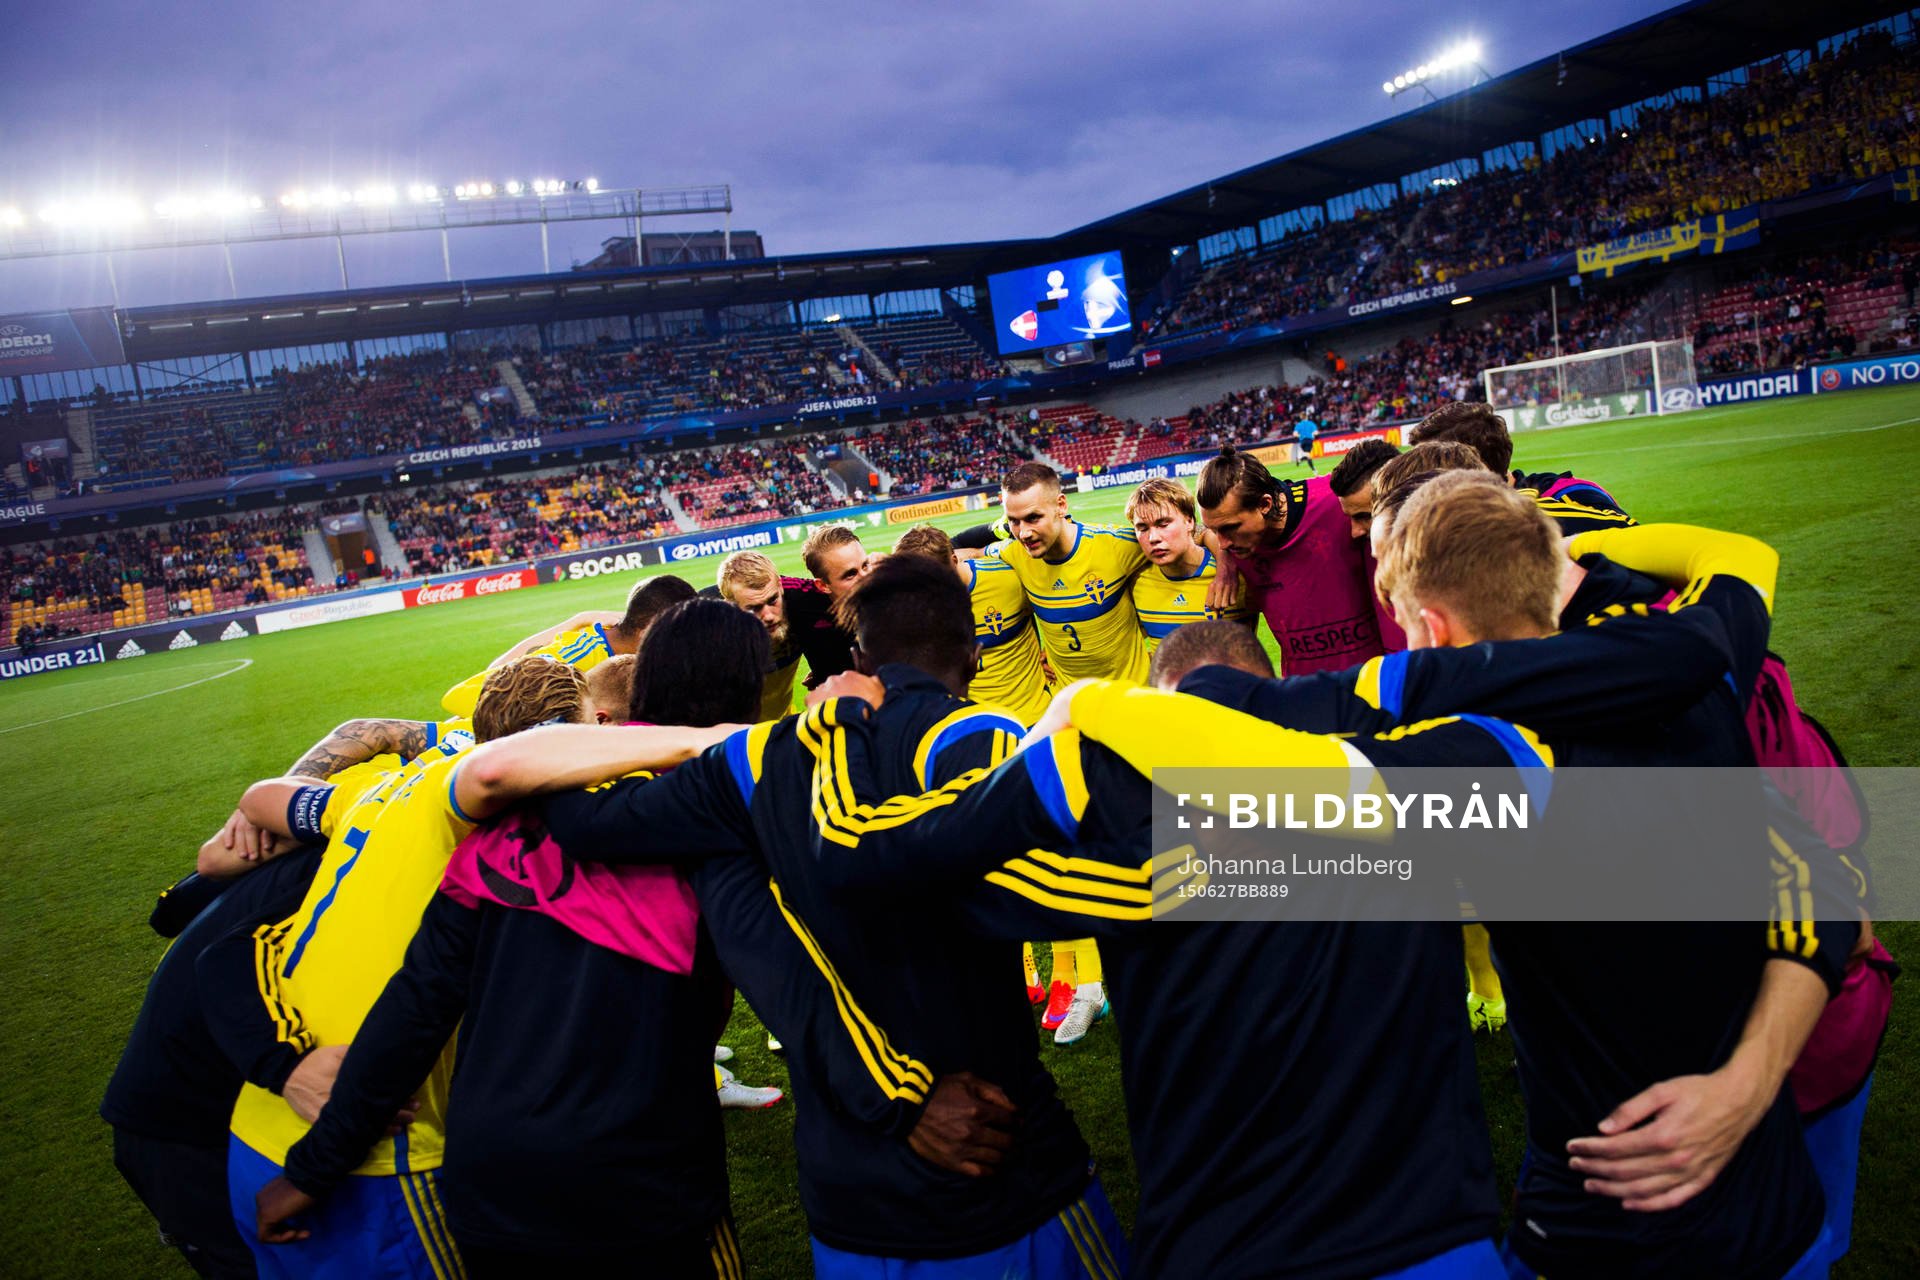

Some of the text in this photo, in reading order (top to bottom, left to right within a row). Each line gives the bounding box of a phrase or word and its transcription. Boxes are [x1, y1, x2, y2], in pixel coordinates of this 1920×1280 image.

[1348, 282, 1457, 316] CZECH REPUBLIC 2015
[0, 334, 52, 349] DER21
[1108, 357, 1136, 370] PRAGUE
[1852, 361, 1920, 385] NO TO
[1696, 374, 1799, 405] HYUNDAI
[805, 396, 878, 413] UEFA UNDER-21
[1545, 402, 1611, 425] Carlsberg
[409, 437, 542, 464] CZECH REPUBLIC 2015
[1093, 473, 1116, 488] UEFA
[1116, 469, 1147, 484] UNDER
[1147, 468, 1157, 479] 21
[1175, 459, 1208, 477] PRAG
[889, 502, 953, 523] Continental
[699, 527, 771, 555] HYUNDAI
[568, 552, 643, 580] SOCAR
[1062, 624, 1082, 652] 3
[1289, 618, 1373, 654] RESPEC
[0, 647, 100, 678] UNDER 21
[308, 800, 321, 834] RACISM
[282, 826, 371, 979] 7
